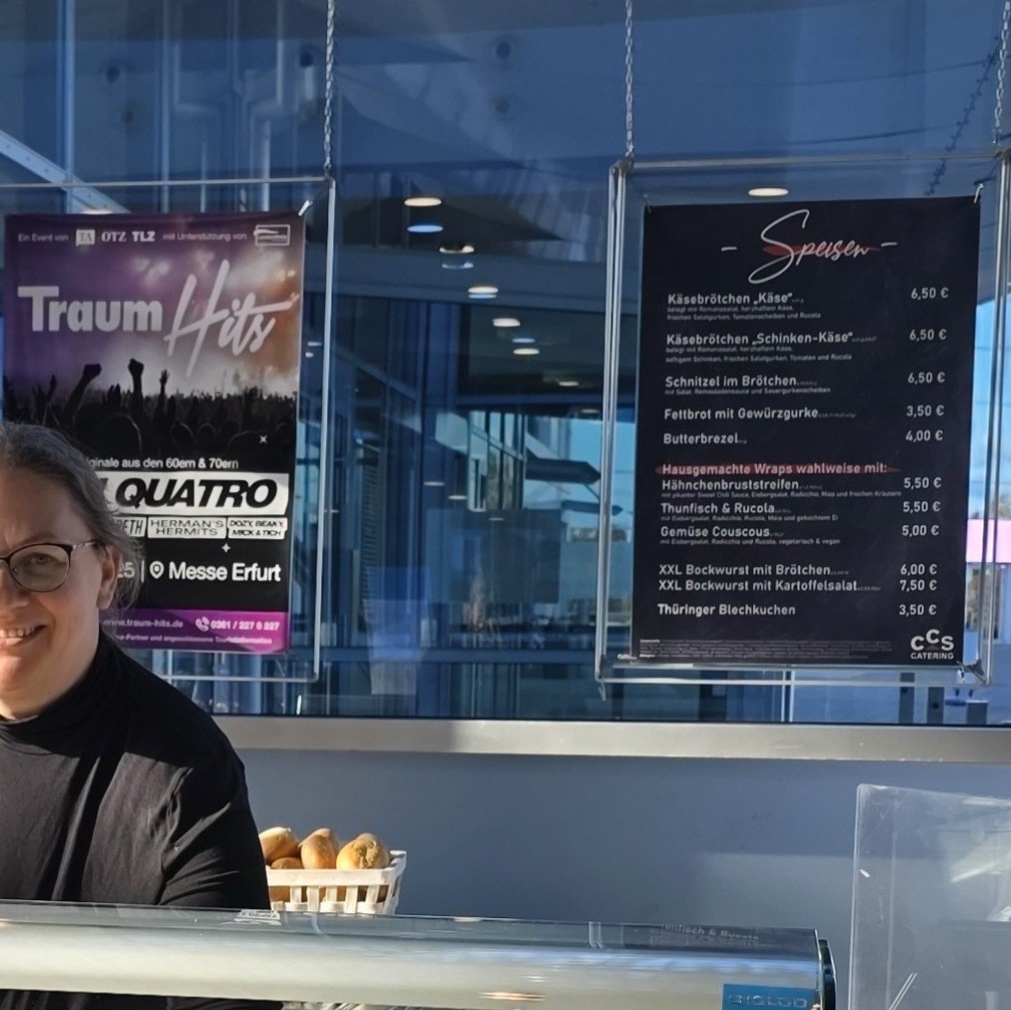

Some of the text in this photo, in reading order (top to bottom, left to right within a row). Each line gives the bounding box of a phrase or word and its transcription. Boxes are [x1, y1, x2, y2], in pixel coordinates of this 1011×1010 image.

[32, 233, 53, 242] Event
[101, 231, 127, 242] OTZ
[132, 230, 156, 242] TLZ
[748, 209, 870, 285] Speisen
[668, 292, 751, 305] Käsebrötchen
[911, 287, 937, 300] 6,50
[941, 287, 950, 299] €
[17, 258, 300, 378] Traum Hits
[666, 333, 749, 346] Käsebrötchen
[909, 328, 935, 342] 6,50
[938, 328, 948, 340] €
[665, 371, 946, 387] Schnitzel im Brötchen 6,50 €
[664, 404, 945, 421] Fettbrot mit Gewürzgurke 3,50 €
[663, 429, 944, 445] Butterbrezel 4,00 €
[121, 457, 239, 469] aus den 60ern & 70ern
[662, 462, 888, 477] Hausgemachte Wraps wahlweise mit:
[661, 476, 942, 491] Hähnchenbruststreifen 5,50 €
[115, 477, 278, 509] QUATRO
[660, 501, 941, 514] Thunfisch & Rucola 5,50 €
[155, 527, 219, 536] HERMITS
[660, 524, 940, 538] Gemüse Couscous 5,00 €
[168, 561, 282, 582] Messe Erfurt
[658, 562, 938, 577] XXL Bockwurst mit Brötchen 6,00 €
[658, 578, 938, 593] XXL Bockwurst mit Kartoffelsalat 7,50 €
[657, 602, 938, 618] Thüringer Blechkuchen 3,50 €
[910, 628, 955, 651] CCS
[910, 652, 955, 660] CATERING
